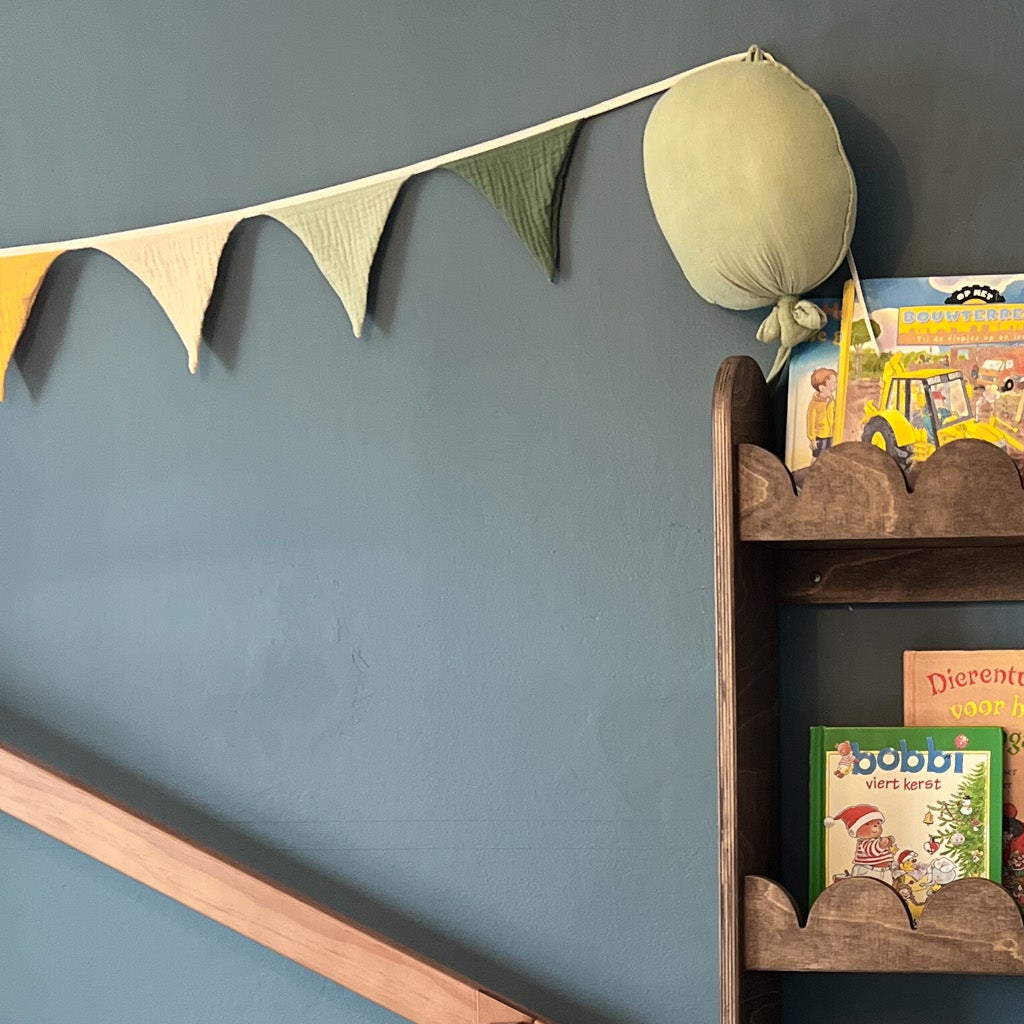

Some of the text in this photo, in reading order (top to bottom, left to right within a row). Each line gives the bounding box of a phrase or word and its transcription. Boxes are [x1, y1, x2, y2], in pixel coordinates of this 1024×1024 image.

[950, 698, 1005, 721] voor
[851, 736, 964, 776] bobbi
[866, 776, 942, 791] viert kerst
